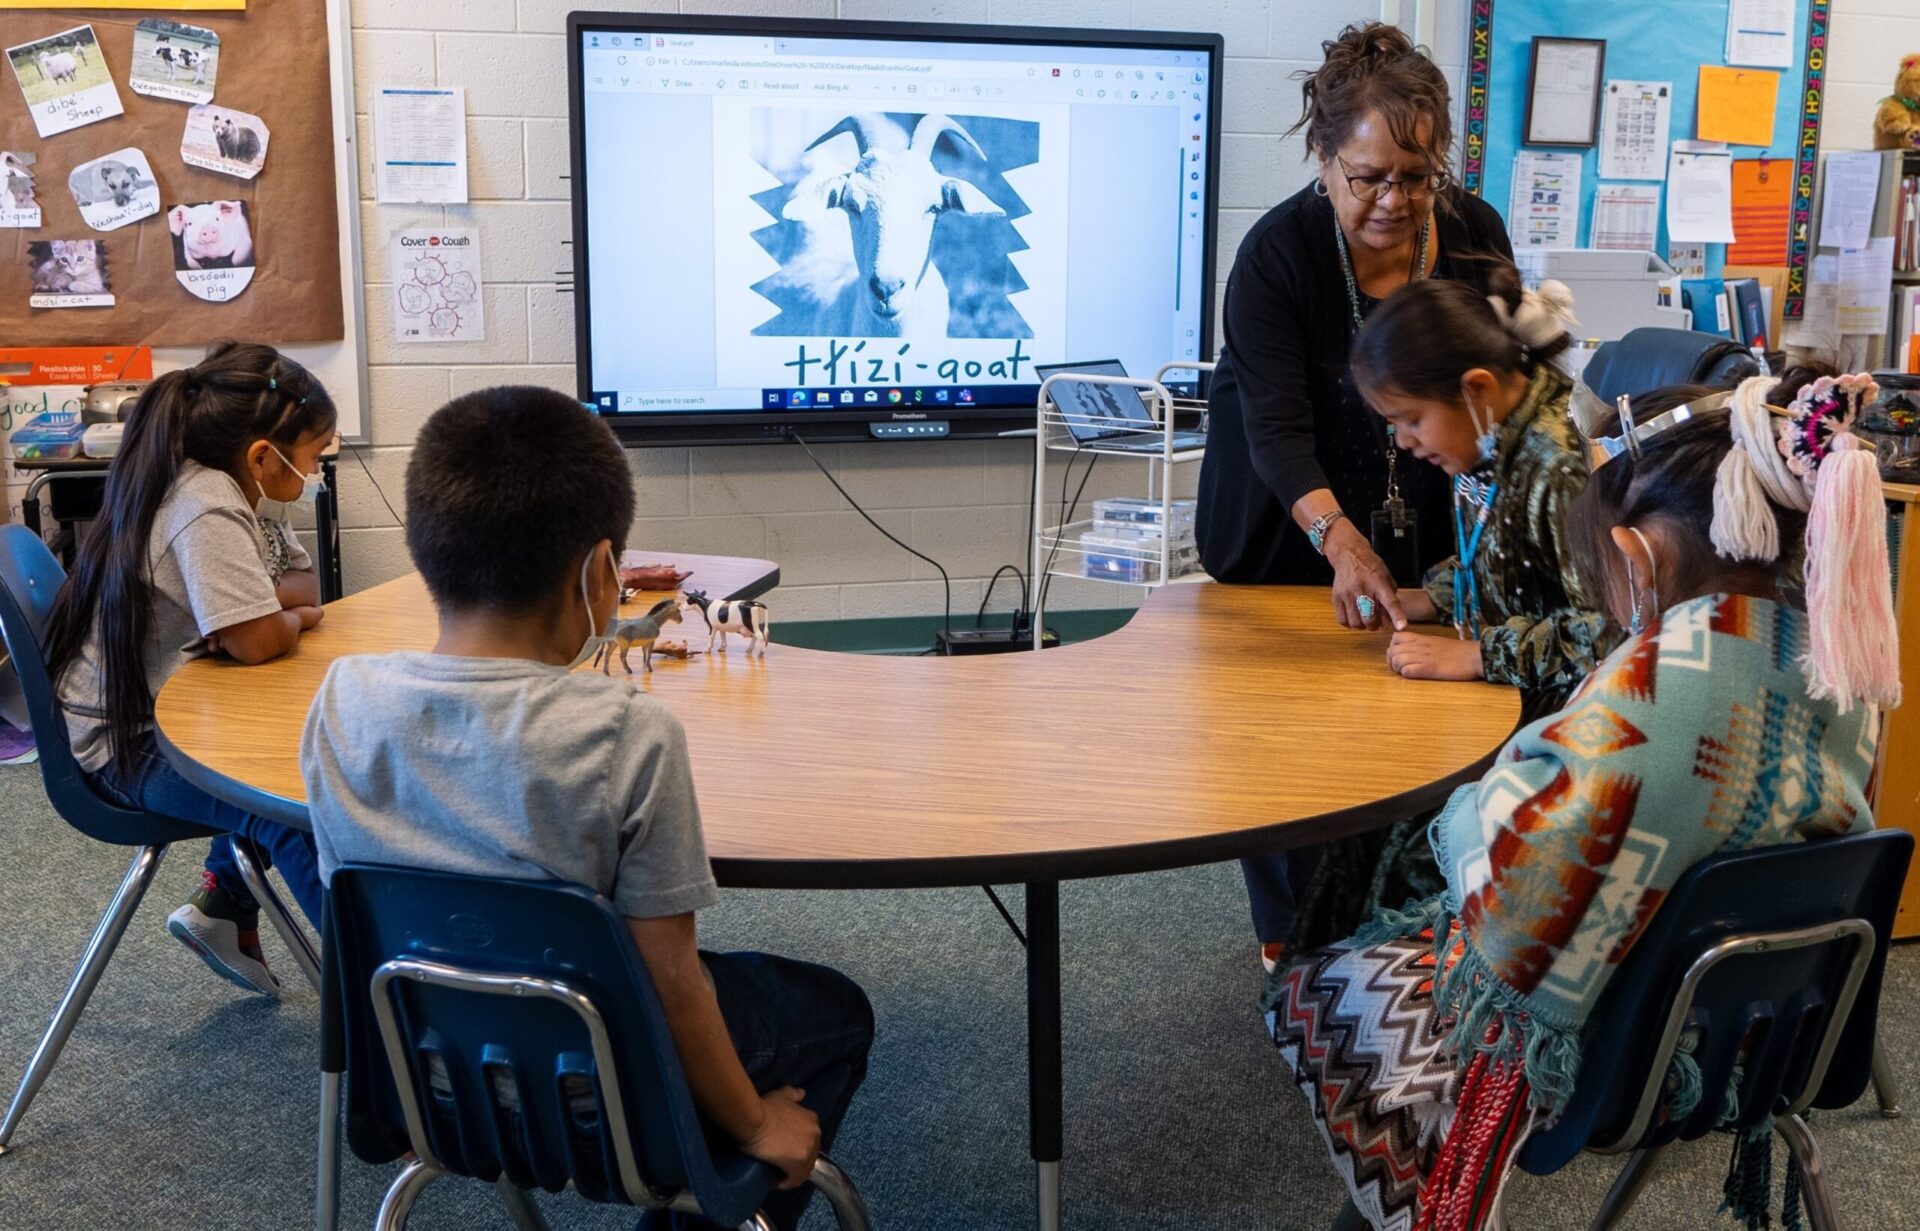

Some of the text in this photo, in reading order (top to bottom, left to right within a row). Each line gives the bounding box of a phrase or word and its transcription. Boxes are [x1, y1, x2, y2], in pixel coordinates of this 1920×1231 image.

[675, 79, 693, 87] Draw
[826, 84, 841, 92] Bing
[400, 236, 428, 247] Cover
[442, 235, 470, 247] Cough
[206, 285, 227, 300] pig
[39, 364, 86, 373] Restickable
[91, 364, 102, 373] 30
[49, 372, 86, 380] Easel Pad
[92, 372, 119, 380] Sheets
[638, 397, 655, 406] Type
[683, 396, 705, 404] search
[892, 412, 927, 420] Promethean
